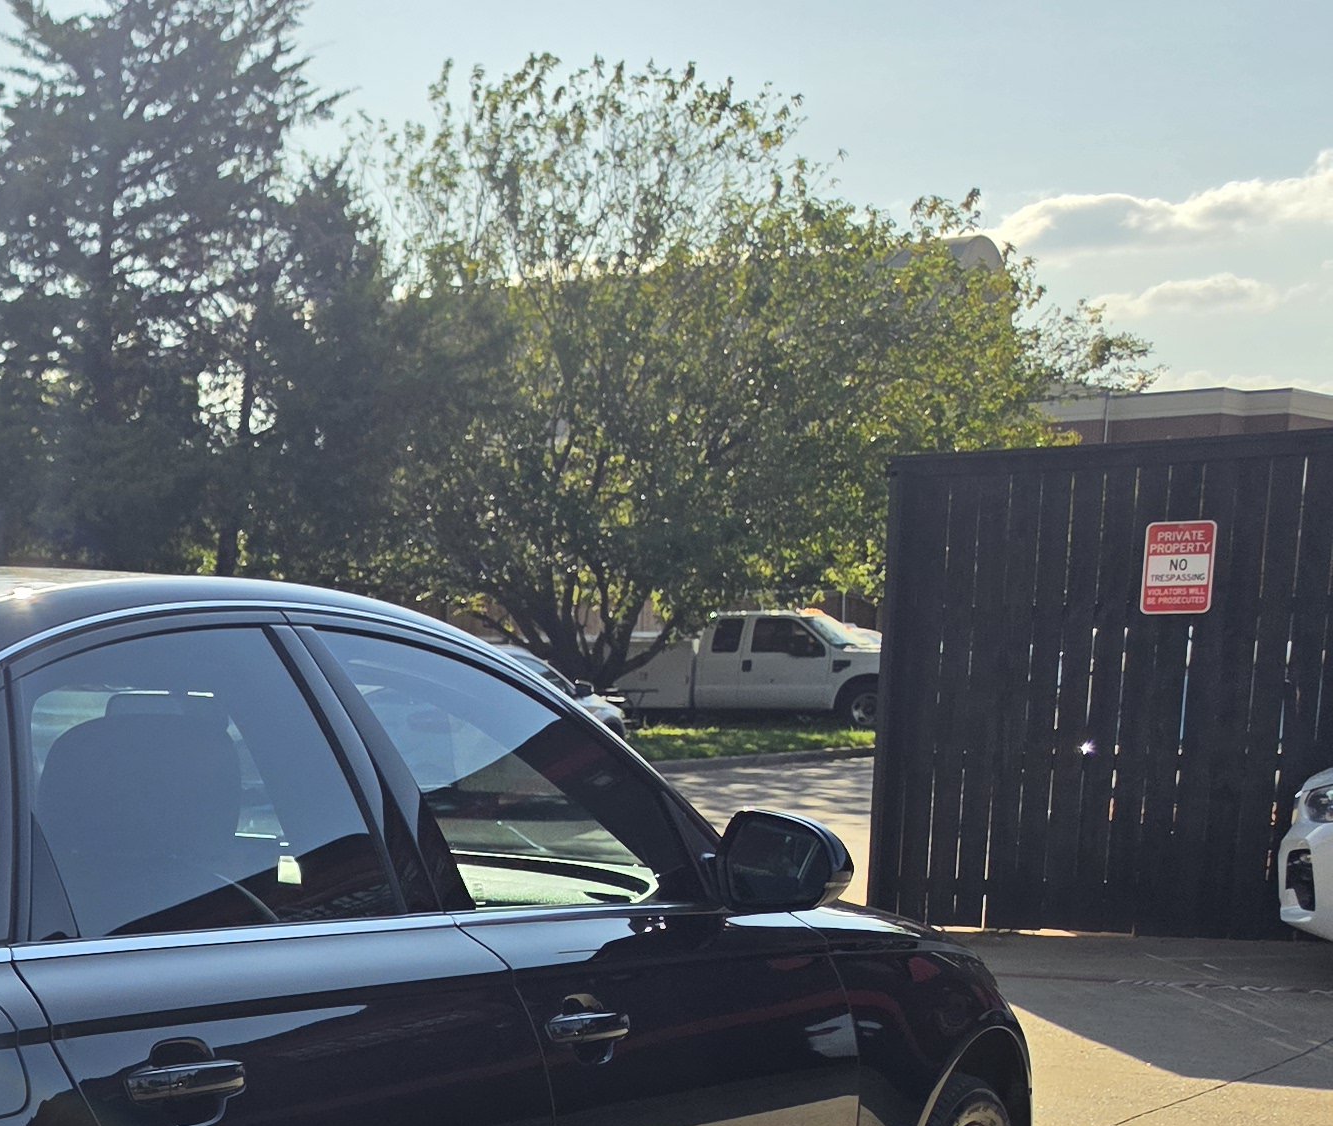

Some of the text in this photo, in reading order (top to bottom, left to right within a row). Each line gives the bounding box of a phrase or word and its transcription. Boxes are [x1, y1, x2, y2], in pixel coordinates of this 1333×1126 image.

[1157, 530, 1205, 541] PRIVATE
[1149, 542, 1211, 554] PROPERTY
[1169, 559, 1188, 571] NO
[1150, 573, 1205, 582] TRESPASSING
[1146, 587, 1206, 596] VIOLATORS WILL
[1146, 596, 1206, 605] BE PROSECUTED
